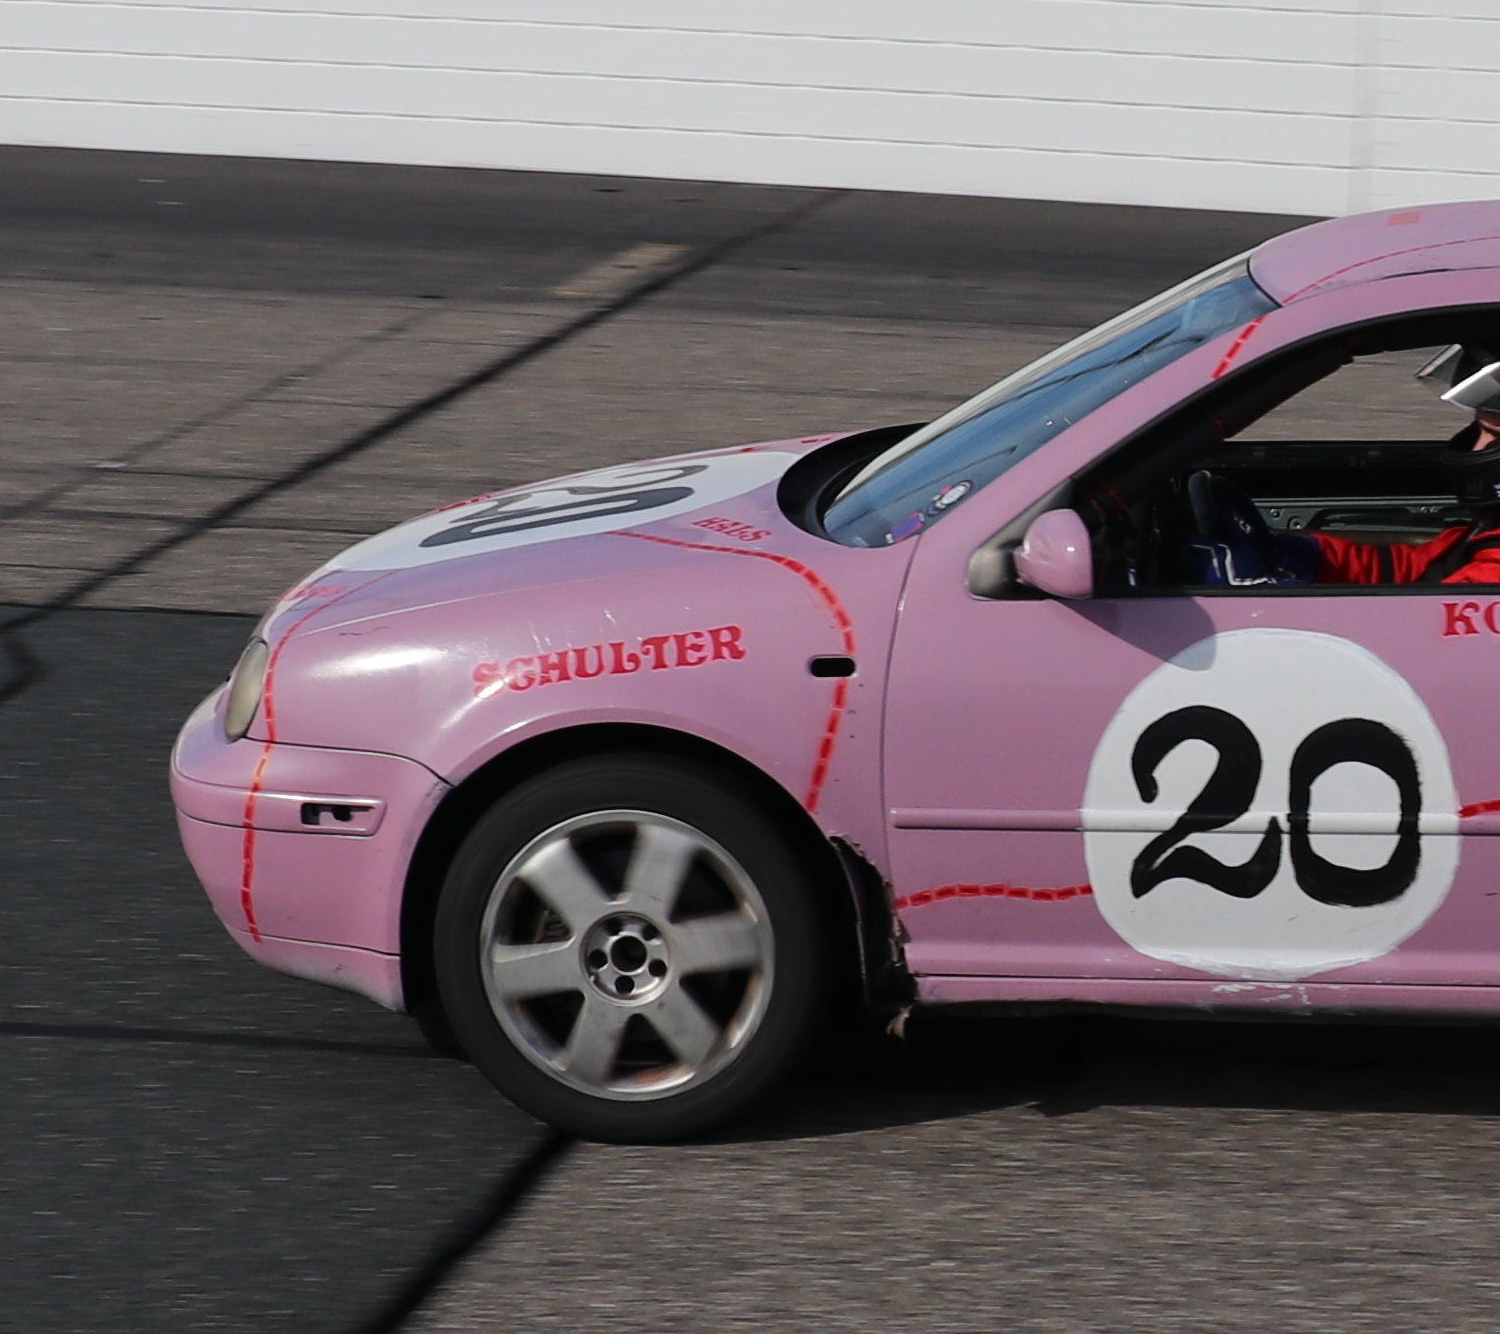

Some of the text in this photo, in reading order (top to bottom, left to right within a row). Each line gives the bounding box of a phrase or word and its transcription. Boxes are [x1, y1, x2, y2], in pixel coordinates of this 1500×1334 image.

[690, 517, 772, 542] HALS
[473, 624, 748, 697] SCHULTER
[1131, 705, 1423, 908] 20
